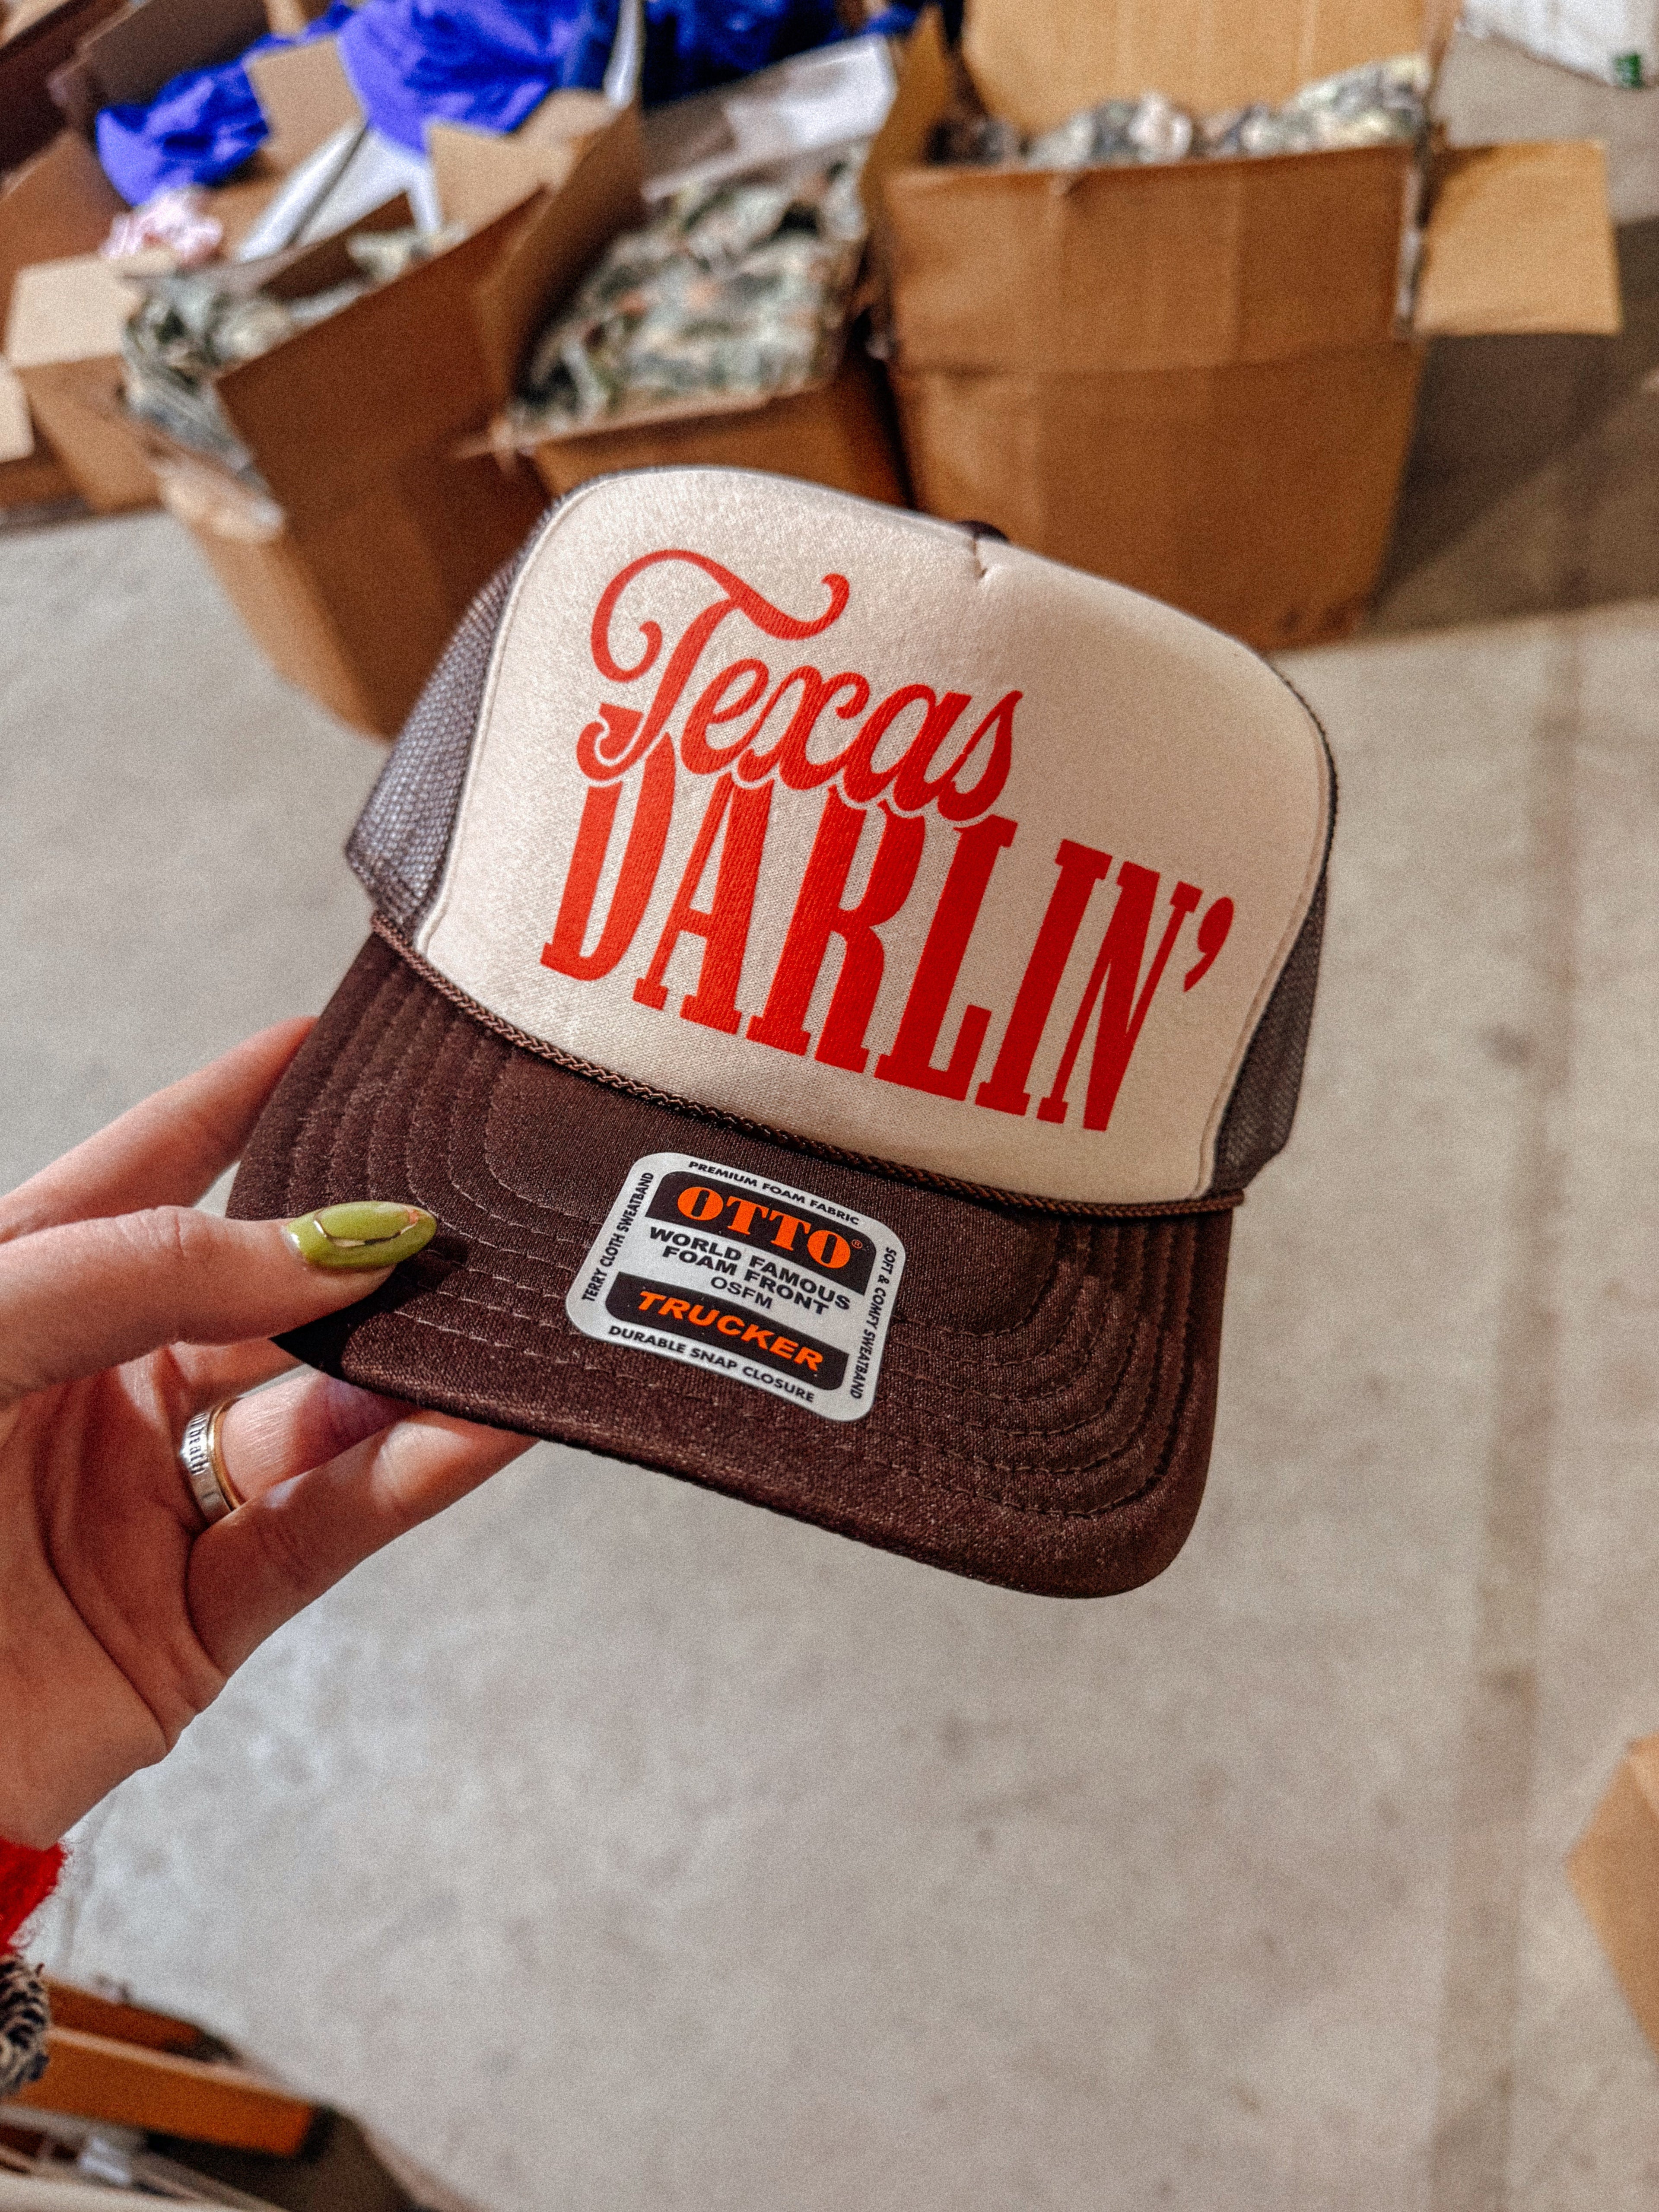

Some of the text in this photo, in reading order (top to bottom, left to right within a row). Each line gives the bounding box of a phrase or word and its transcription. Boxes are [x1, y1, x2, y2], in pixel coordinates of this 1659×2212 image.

[577, 550, 1023, 822] Texas
[689, 1161, 859, 1225] PREMIUM FOAM FABRIC
[582, 1173, 654, 1301] TERRY CLOTH SWEATBAND
[649, 1227, 850, 1310] WORLD FAMOUS
[662, 1246, 829, 1315] FOAM FRONT
[711, 1277, 773, 1309] OSFM
[639, 1290, 823, 1371] TRUCKER
[850, 1247, 897, 1399] SOFT & COMFY SWEATBAND
[608, 1325, 814, 1403] DURABLE SNAP CLOSURE
